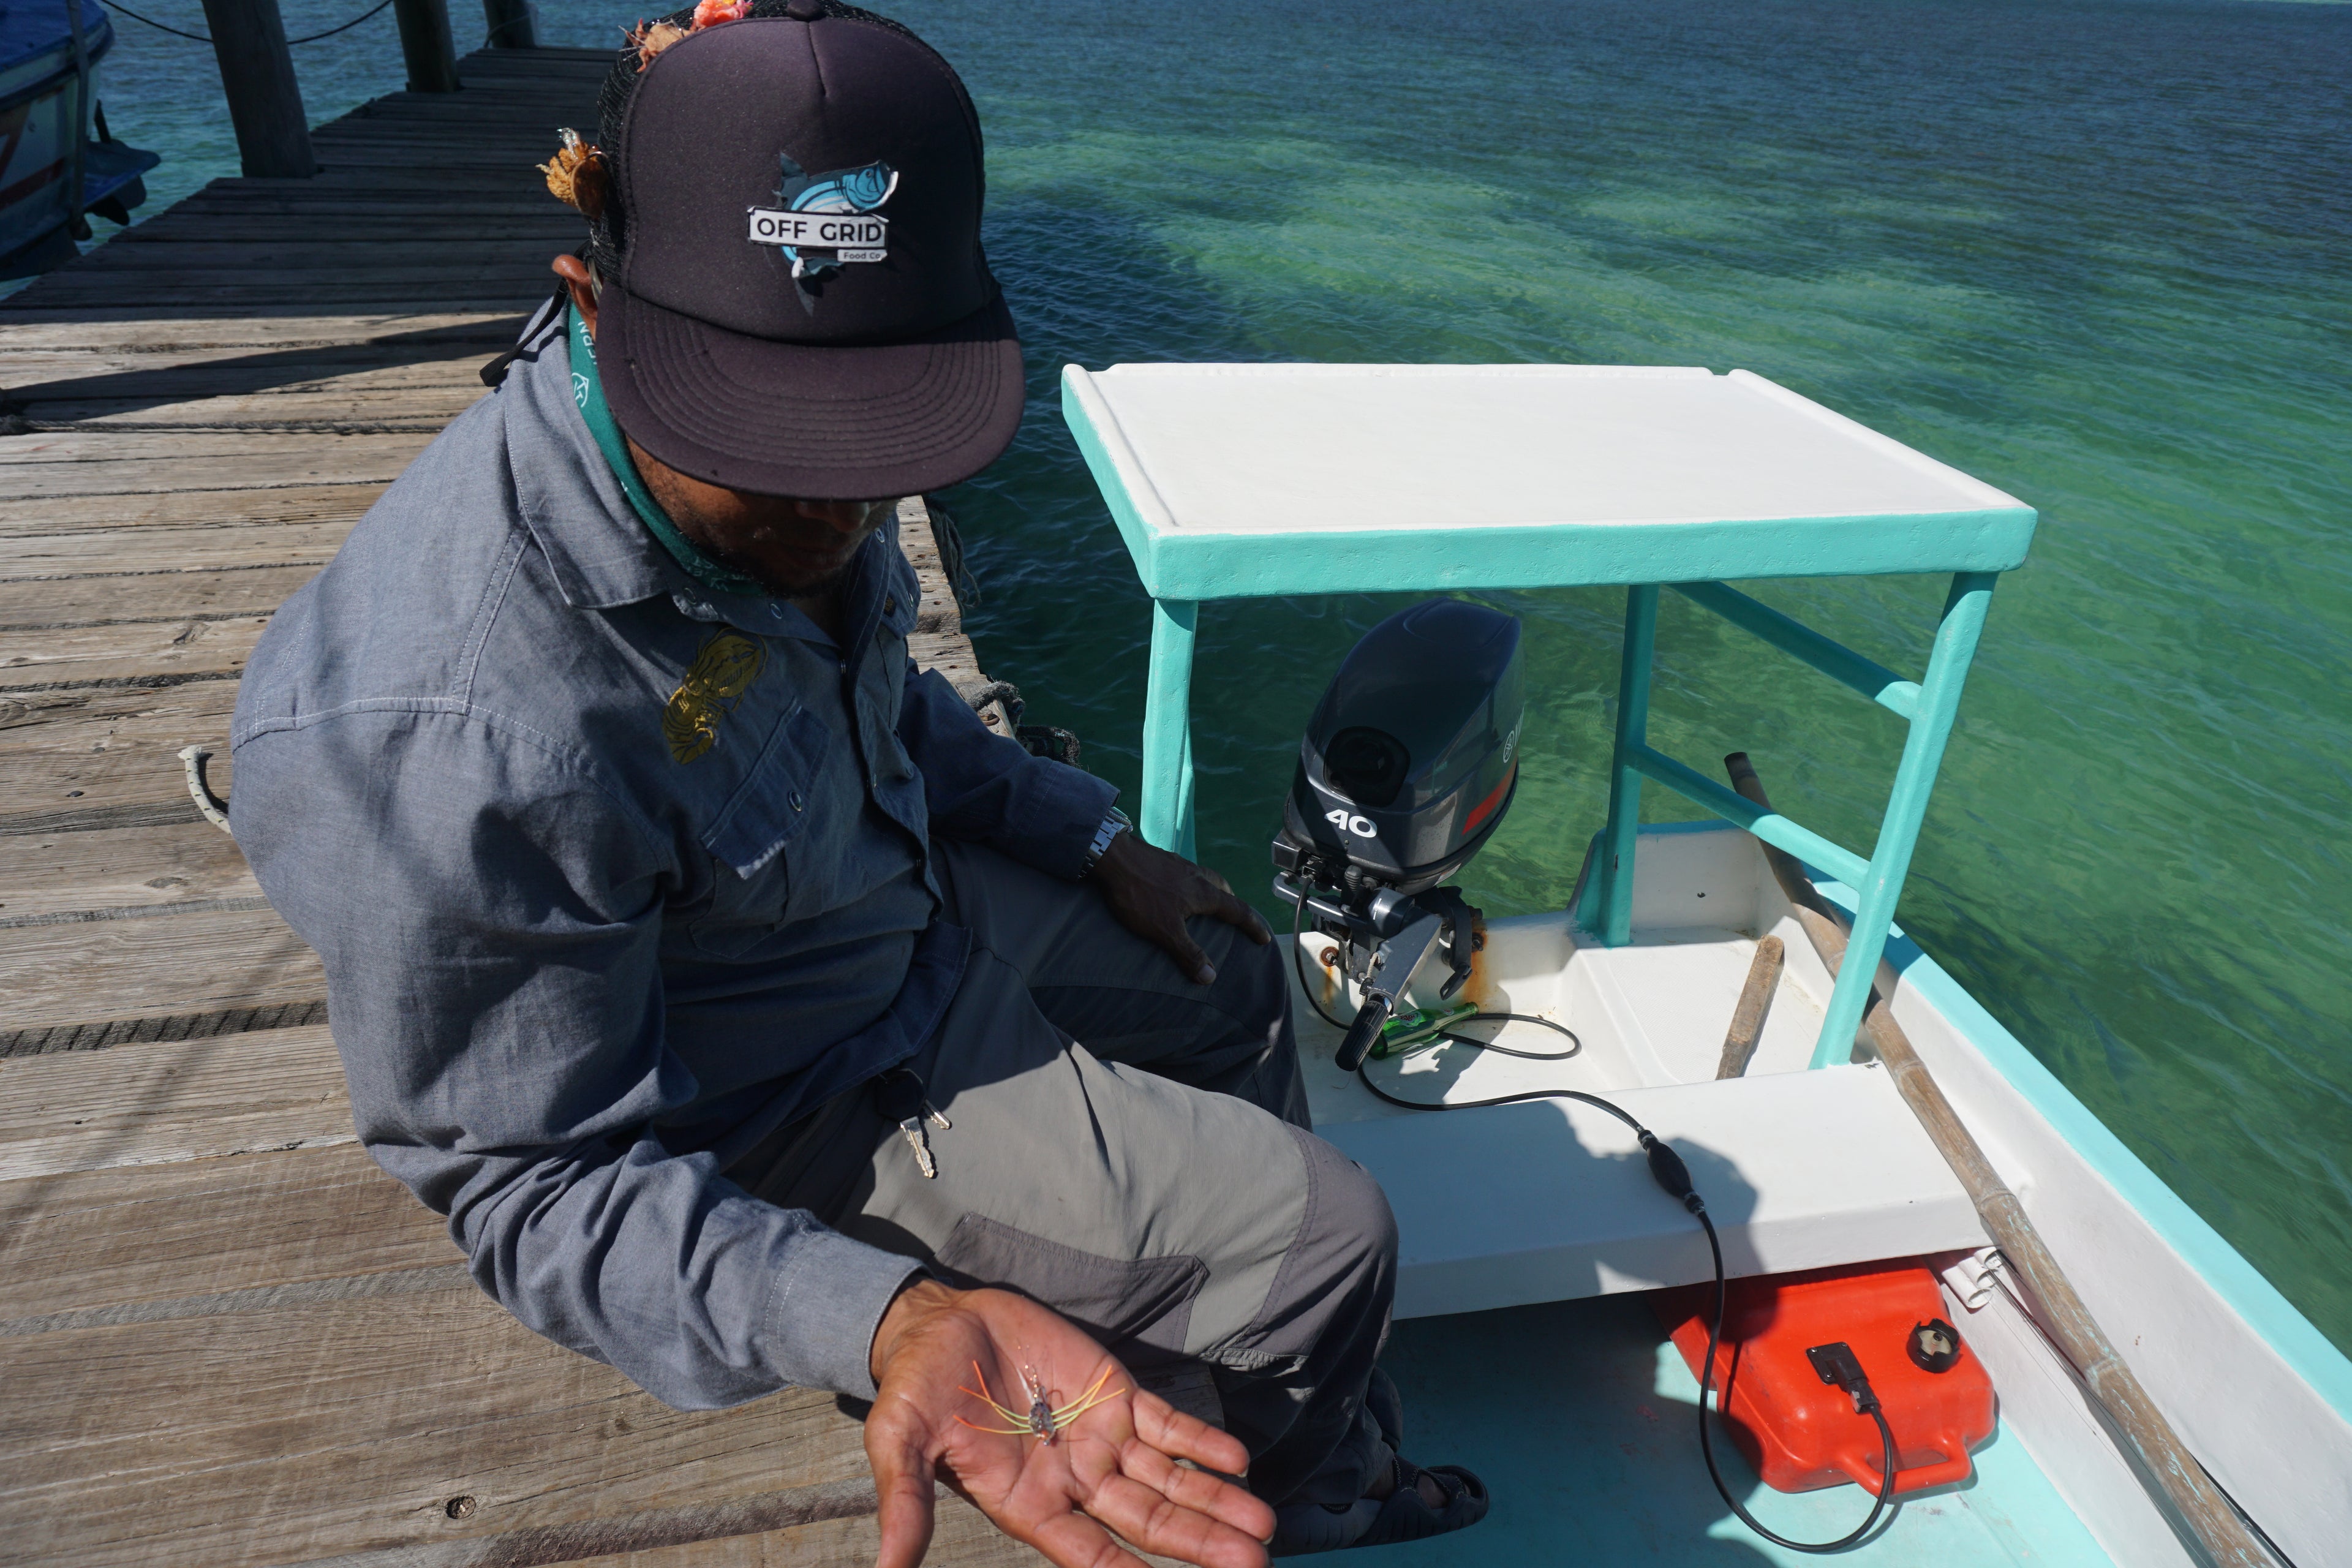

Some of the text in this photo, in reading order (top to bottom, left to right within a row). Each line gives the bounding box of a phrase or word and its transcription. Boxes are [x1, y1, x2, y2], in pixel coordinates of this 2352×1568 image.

[757, 217, 882, 242] OFF GRID
[1324, 809, 1378, 838] 40
